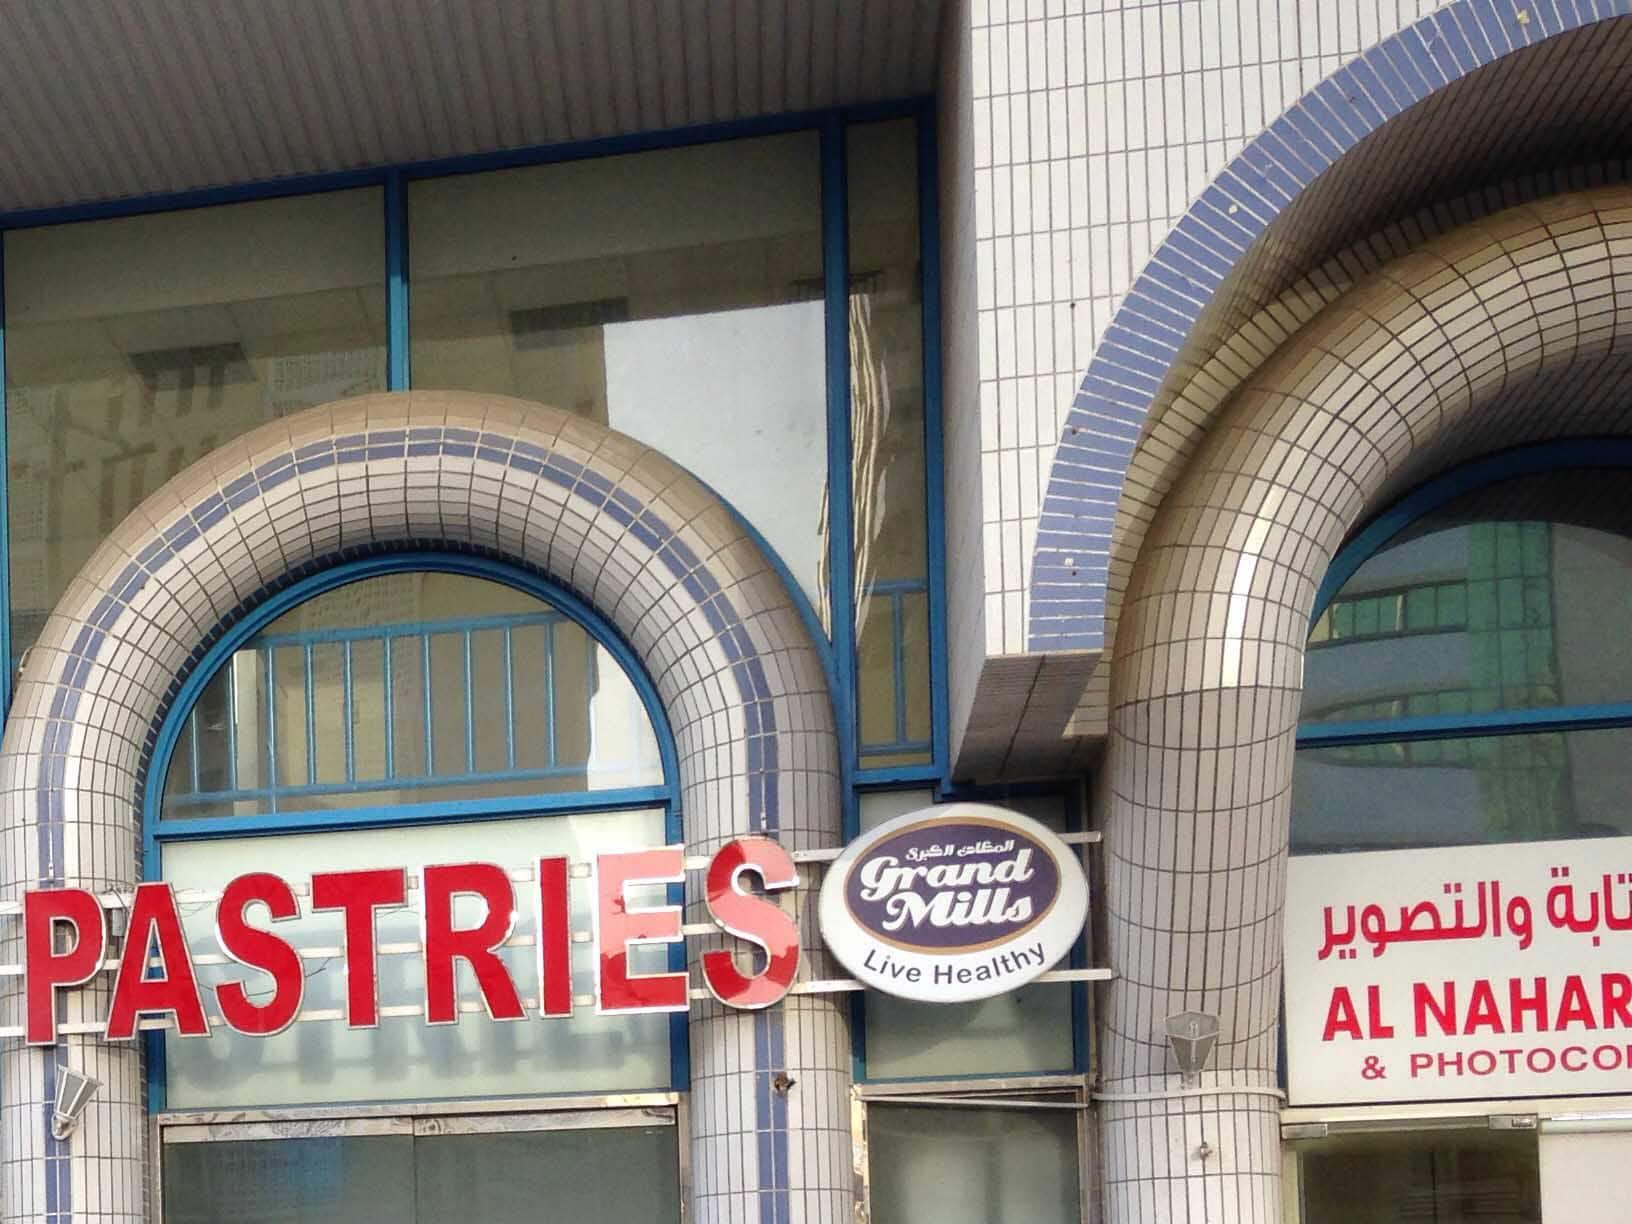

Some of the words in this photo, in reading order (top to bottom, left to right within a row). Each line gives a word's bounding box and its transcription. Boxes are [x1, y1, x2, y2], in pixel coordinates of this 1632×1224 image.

[859, 848, 1035, 901] Grand
[882, 887, 1033, 932] Mills
[1318, 880, 1533, 960] والتصوير
[24, 835, 801, 1045] PASTRIES
[863, 949, 922, 983] Live
[934, 942, 1046, 985] Healthy
[1322, 984, 1395, 1041] AL
[1413, 972, 1632, 1037] NAHAR
[1361, 1055, 1387, 1080] &
[1409, 1044, 1632, 1078] PHOTOCO
